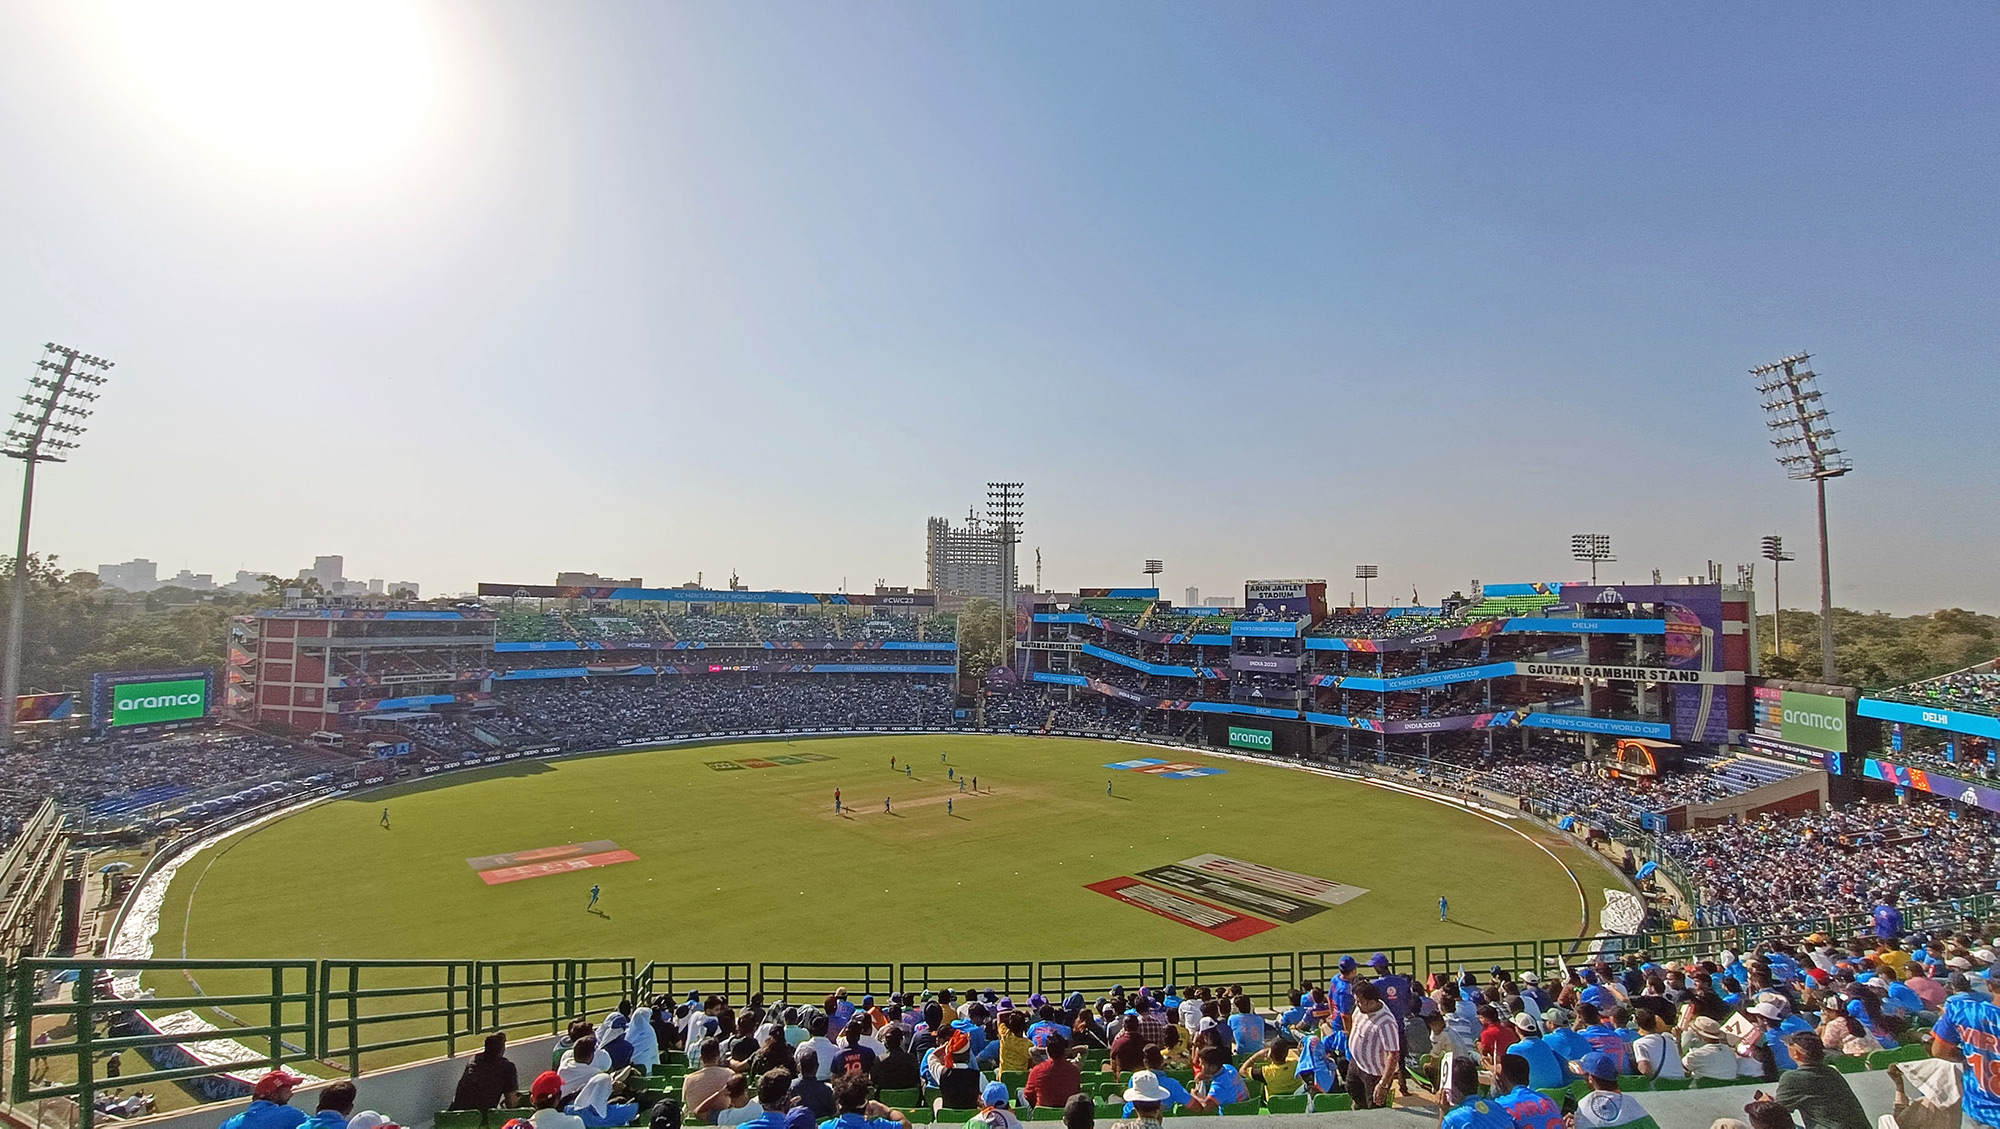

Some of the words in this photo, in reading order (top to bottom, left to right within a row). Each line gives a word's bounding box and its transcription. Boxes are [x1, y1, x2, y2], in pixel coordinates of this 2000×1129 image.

[1410, 634, 1437, 644] #CWC23
[1528, 664, 1580, 676] GAUTAM
[1583, 667, 1646, 680] GAMBHIR
[1649, 670, 1699, 682] STAND
[1417, 676, 1442, 684] CRICKET
[118, 694, 200, 710] aramco
[1784, 709, 1842, 731] aramco
[1923, 712, 1948, 724] DELHI
[1552, 718, 1575, 726] MEN'S
[1576, 721, 1610, 729] CRICKET
[1611, 723, 1641, 732] WORLD
[1230, 732, 1271, 745] aramco
